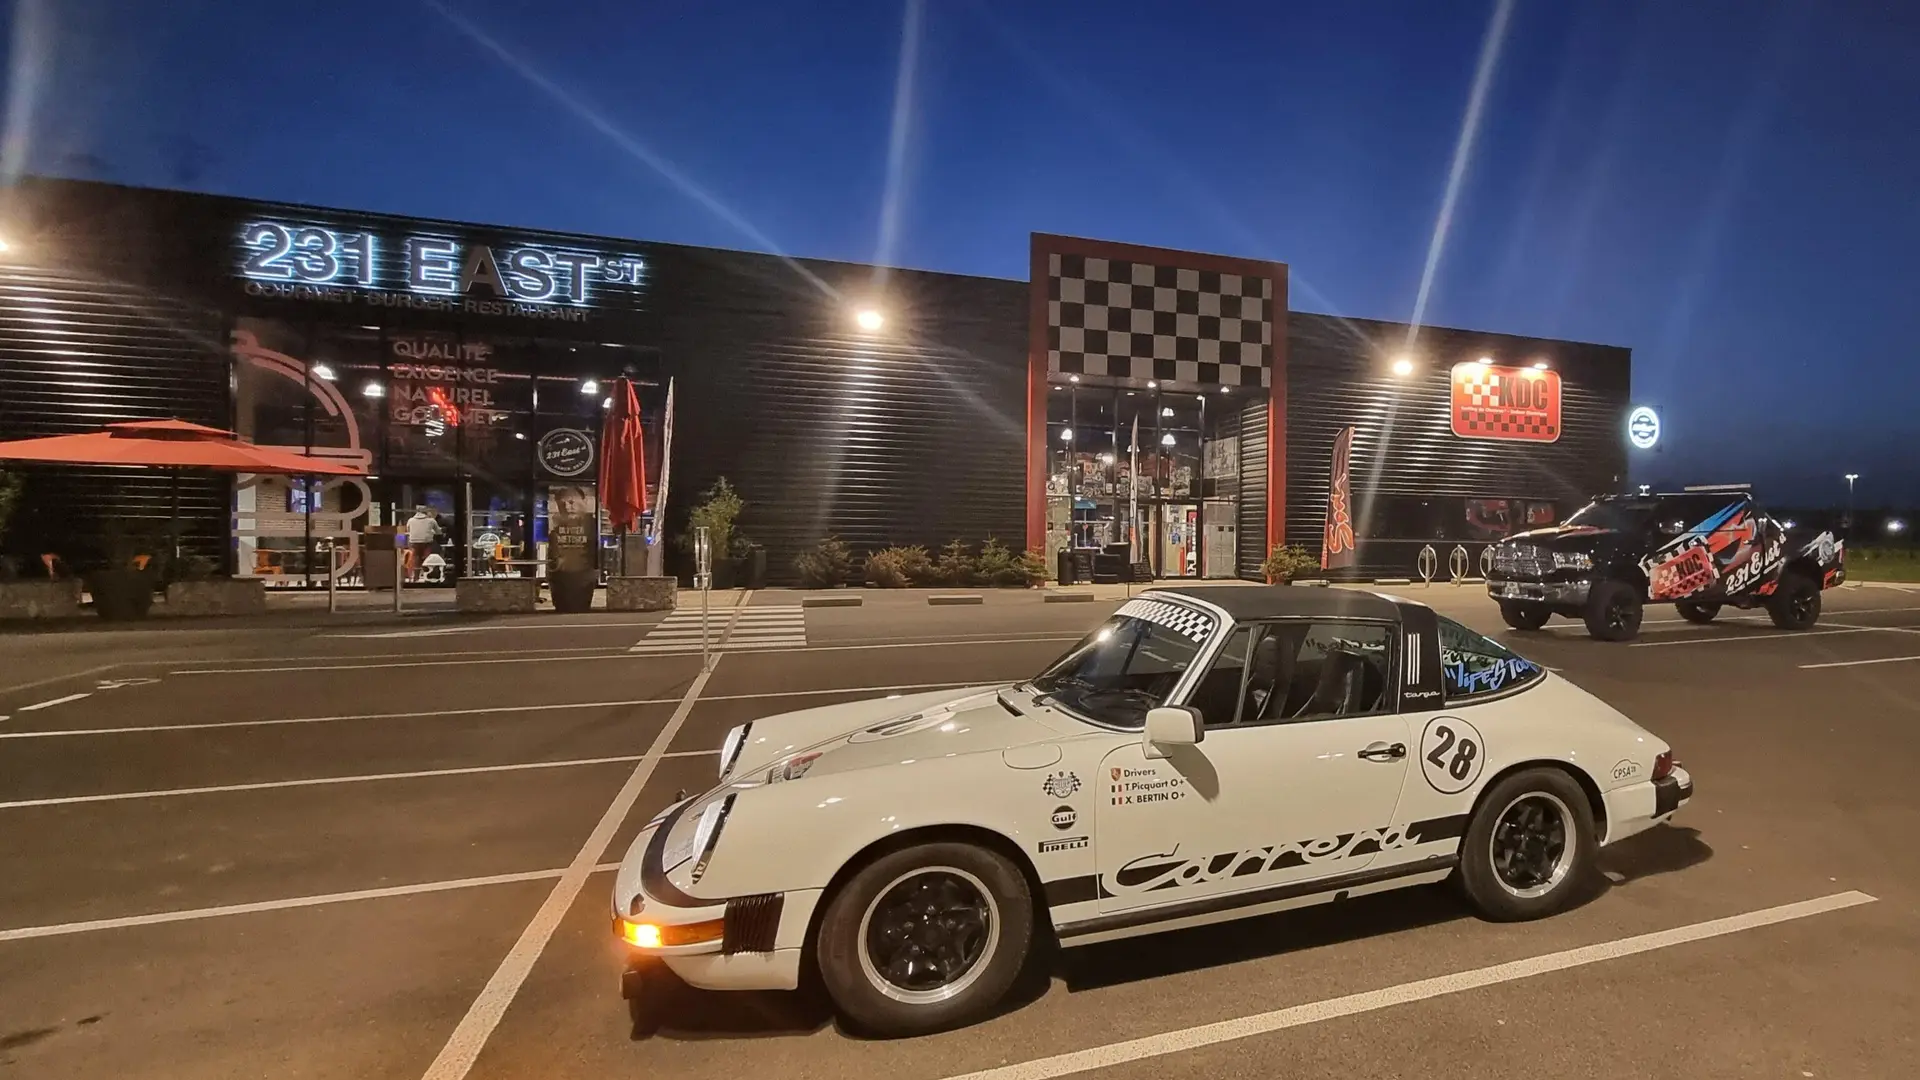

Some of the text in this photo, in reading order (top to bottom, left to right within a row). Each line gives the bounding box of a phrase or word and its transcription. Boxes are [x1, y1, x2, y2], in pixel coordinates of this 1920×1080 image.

[244, 222, 643, 303] 231 EAST ST
[366, 290, 452, 312] BURGER
[464, 300, 590, 323] RESTAURANT
[393, 363, 499, 384] EXIGENCE
[1498, 375, 1548, 410] KDC
[1674, 553, 1703, 579] KDC
[1725, 563, 1750, 594] 231
[1403, 690, 1440, 699] targa
[1426, 725, 1478, 781] 28
[1123, 768, 1156, 778] Drivers
[1136, 792, 1169, 803] BERTIN
[1051, 812, 1077, 823] Gulf
[1037, 835, 1089, 854] PIRELLI
[1100, 823, 1424, 897] Carrera
